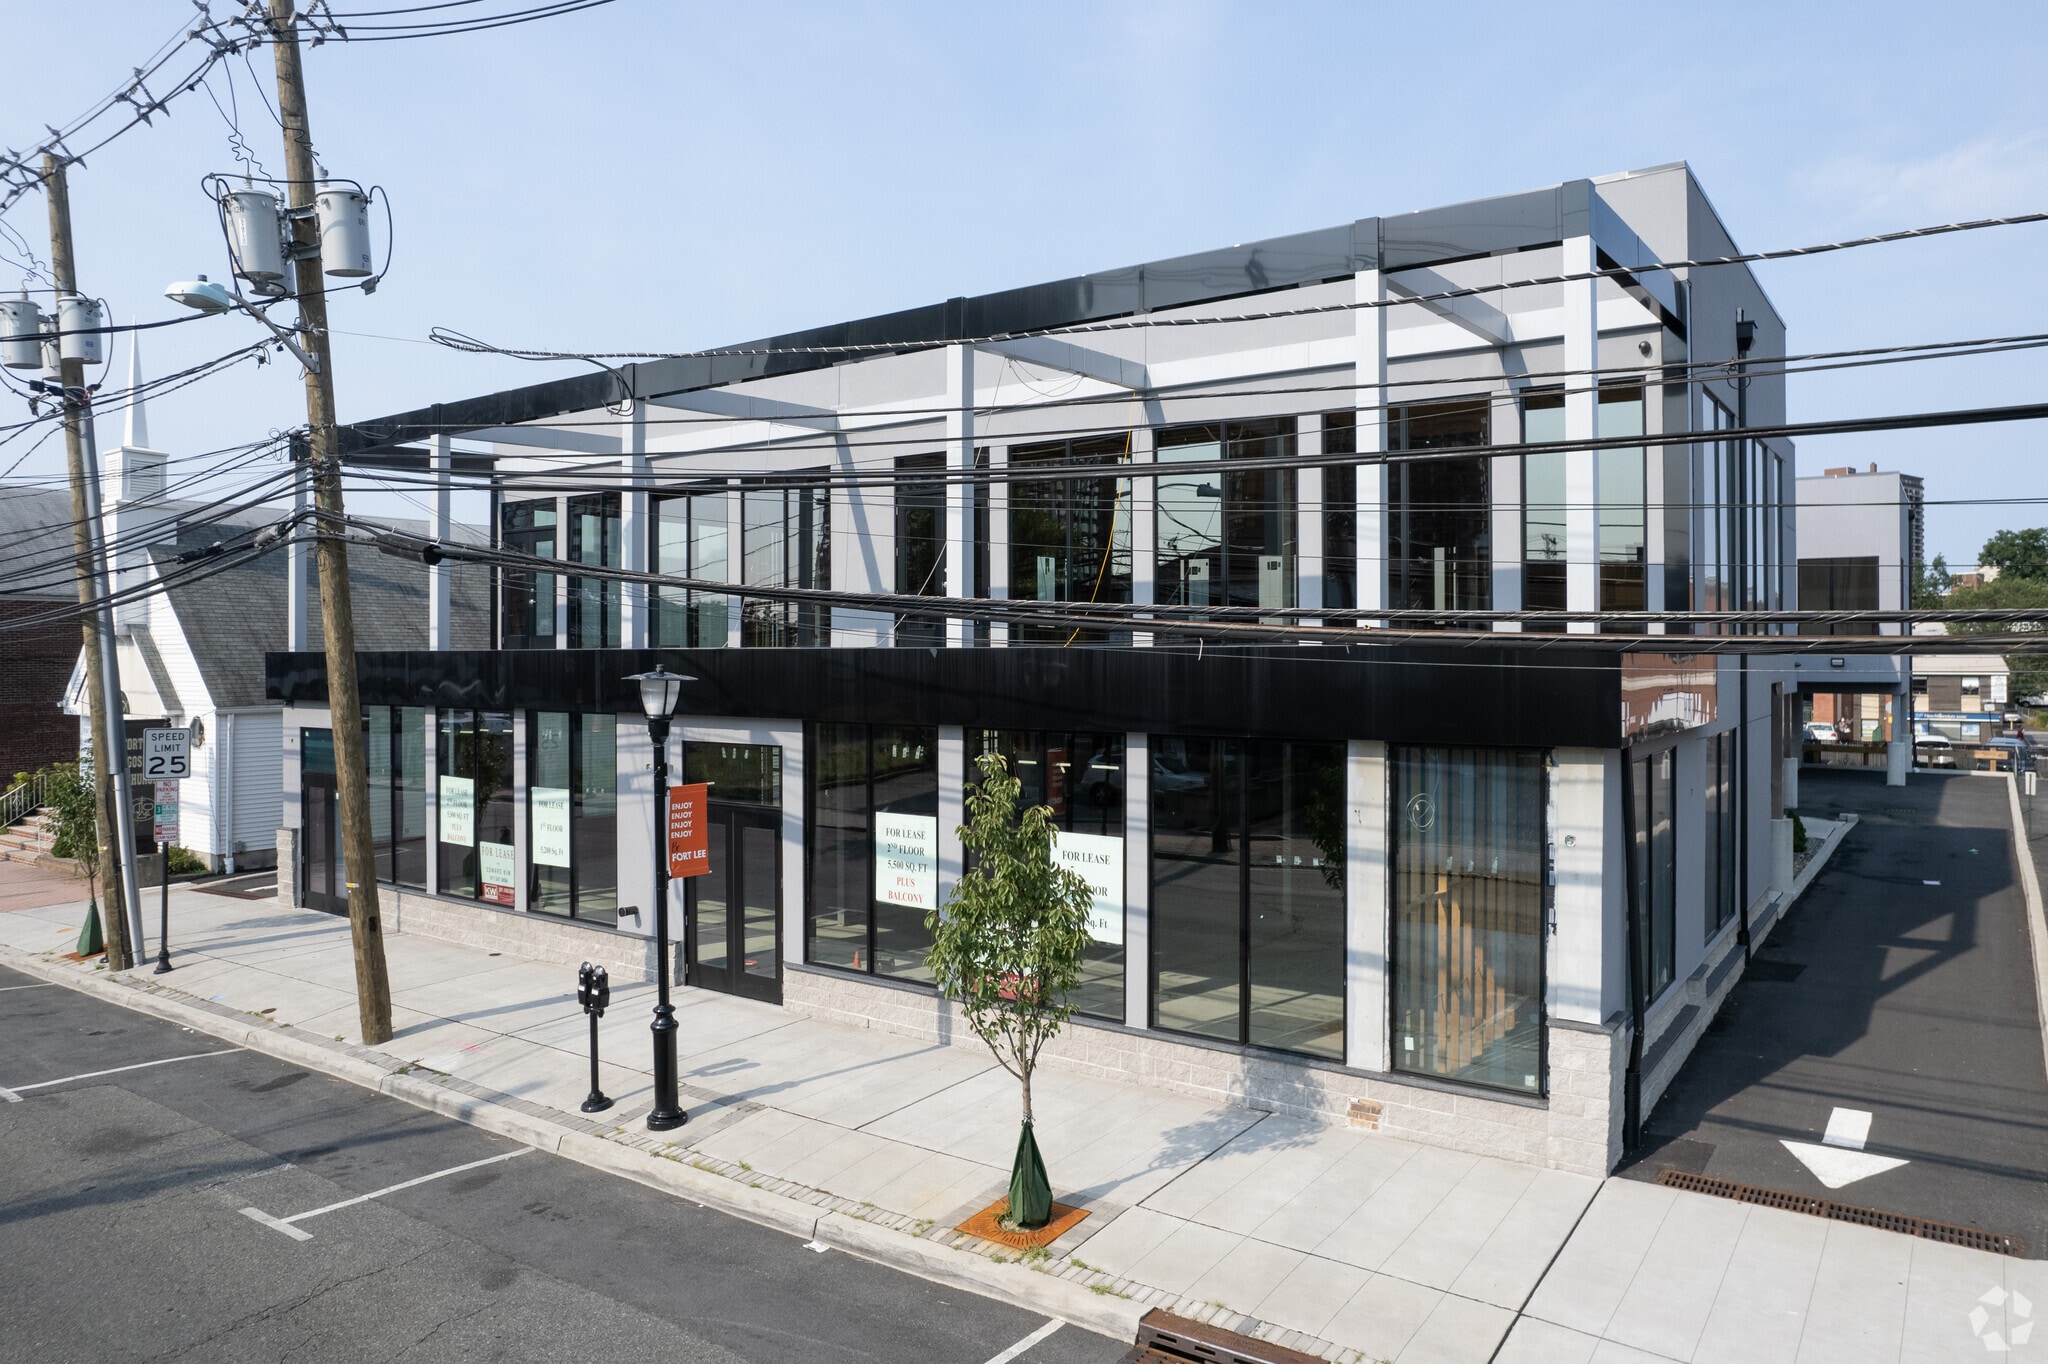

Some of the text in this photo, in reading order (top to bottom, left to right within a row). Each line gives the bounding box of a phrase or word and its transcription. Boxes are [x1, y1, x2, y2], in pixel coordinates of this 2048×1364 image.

[151, 732, 185, 741] SPEED
[126, 738, 144, 750] ORT
[154, 743, 181, 753] LIMIT
[127, 755, 144, 768] GOS
[149, 755, 186, 775] 25
[455, 788, 468, 797] LEASE
[538, 800, 564, 809] FOR LEASE
[671, 801, 693, 810] ENJOY
[671, 811, 693, 820] ENJOY
[546, 823, 564, 833] FLOOR
[671, 820, 693, 829] ENJOY
[671, 830, 693, 839] ENJOY
[885, 827, 926, 840] FOR LEASE
[481, 845, 514, 860] FOR LEASE
[671, 849, 706, 862] FORT LEE
[899, 844, 925, 856] FLOOR
[1062, 849, 1111, 865] FOR LEASE
[918, 863, 928, 873] FT
[896, 876, 916, 888] PLUS
[888, 890, 923, 904] BALCONY
[1099, 918, 1108, 929] Ft
